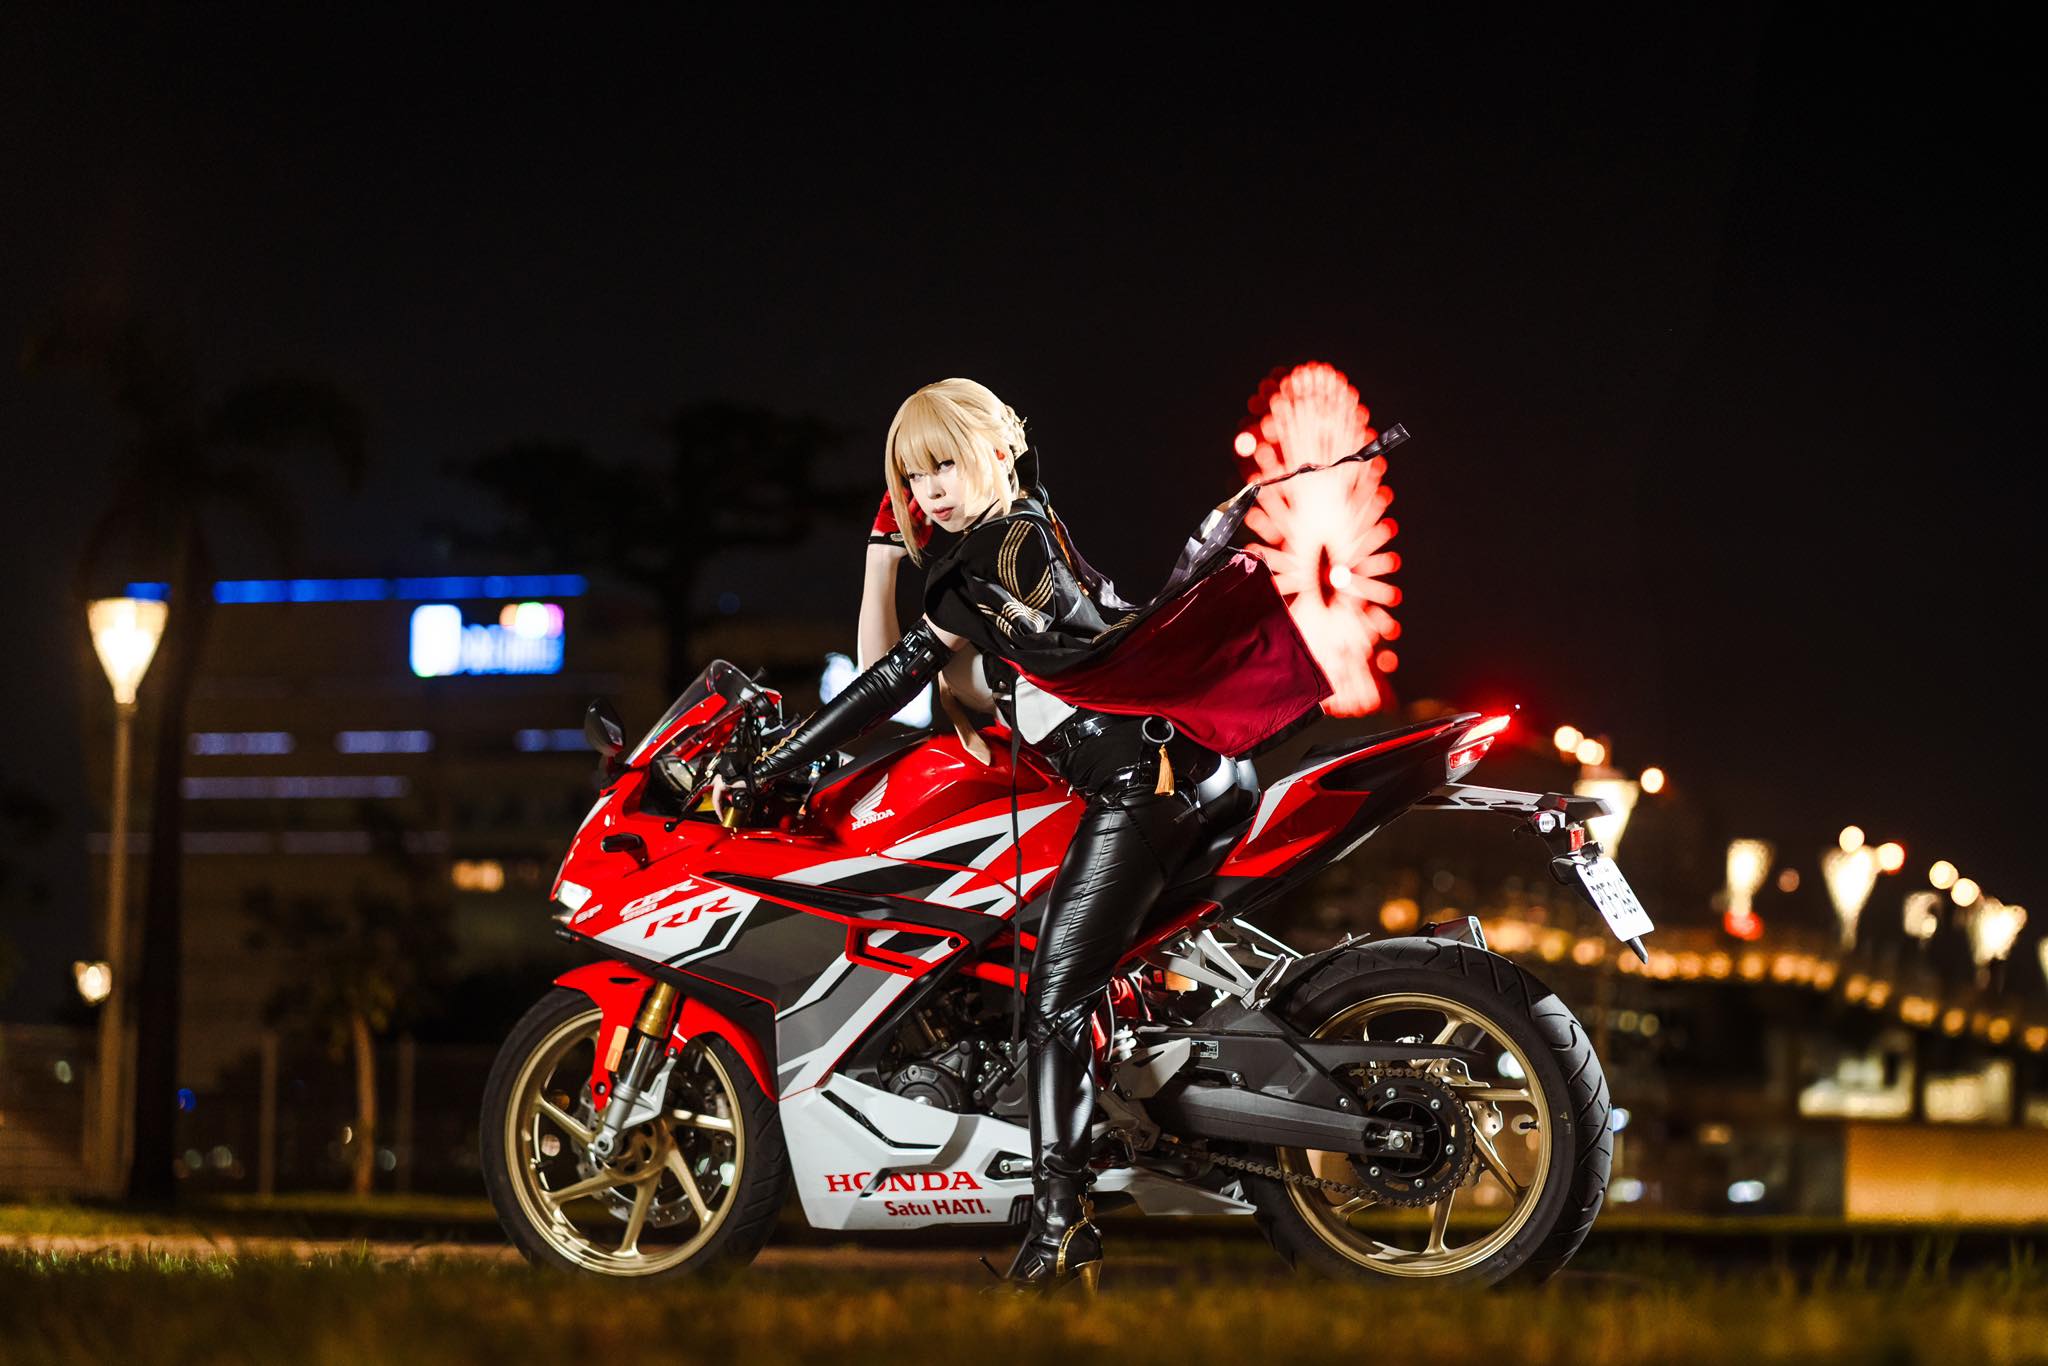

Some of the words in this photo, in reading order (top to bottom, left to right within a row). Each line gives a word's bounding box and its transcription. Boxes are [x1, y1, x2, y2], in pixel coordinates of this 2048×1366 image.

[851, 808, 896, 831] HONDA
[619, 879, 700, 917] CBR
[884, 1201, 932, 1216] Satu
[931, 1199, 991, 1215] HATI.
